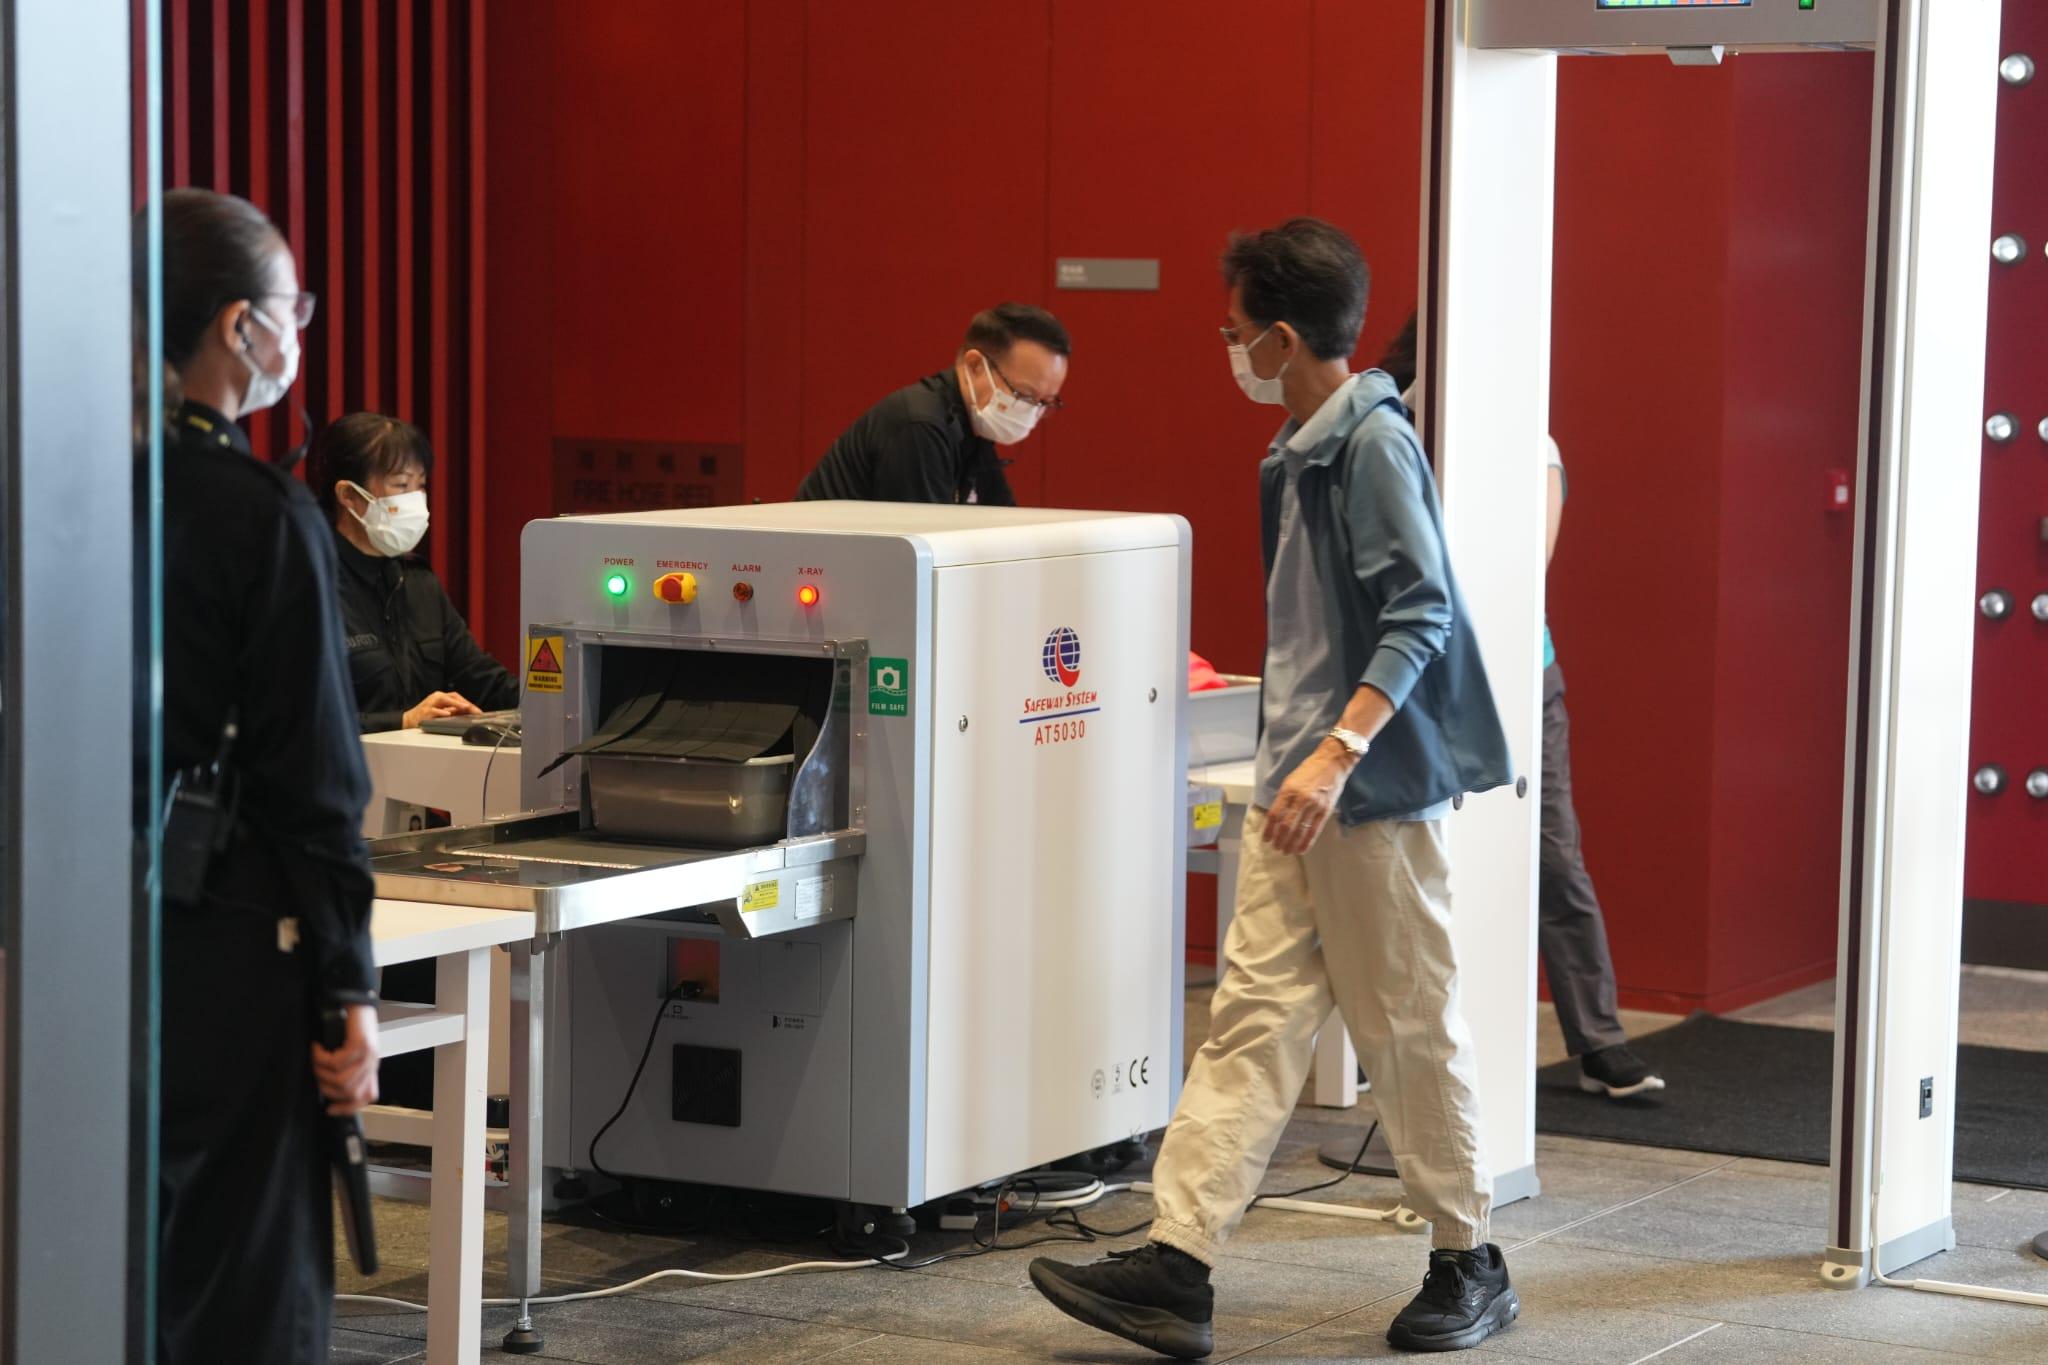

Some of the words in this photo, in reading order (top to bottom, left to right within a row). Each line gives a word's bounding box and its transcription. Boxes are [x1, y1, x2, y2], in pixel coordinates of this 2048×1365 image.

[617, 481, 667, 505] HOSE
[604, 557, 634, 566] POWER
[656, 560, 709, 570] EMERGENCY
[731, 564, 762, 573] ALARM
[798, 567, 824, 575] X-RAY
[889, 703, 905, 712] SAFE
[1023, 698, 1065, 714] SAFEWAY
[1065, 691, 1098, 707] SYSTEM
[1034, 719, 1086, 746] AT5030
[1129, 1055, 1149, 1088] CE
